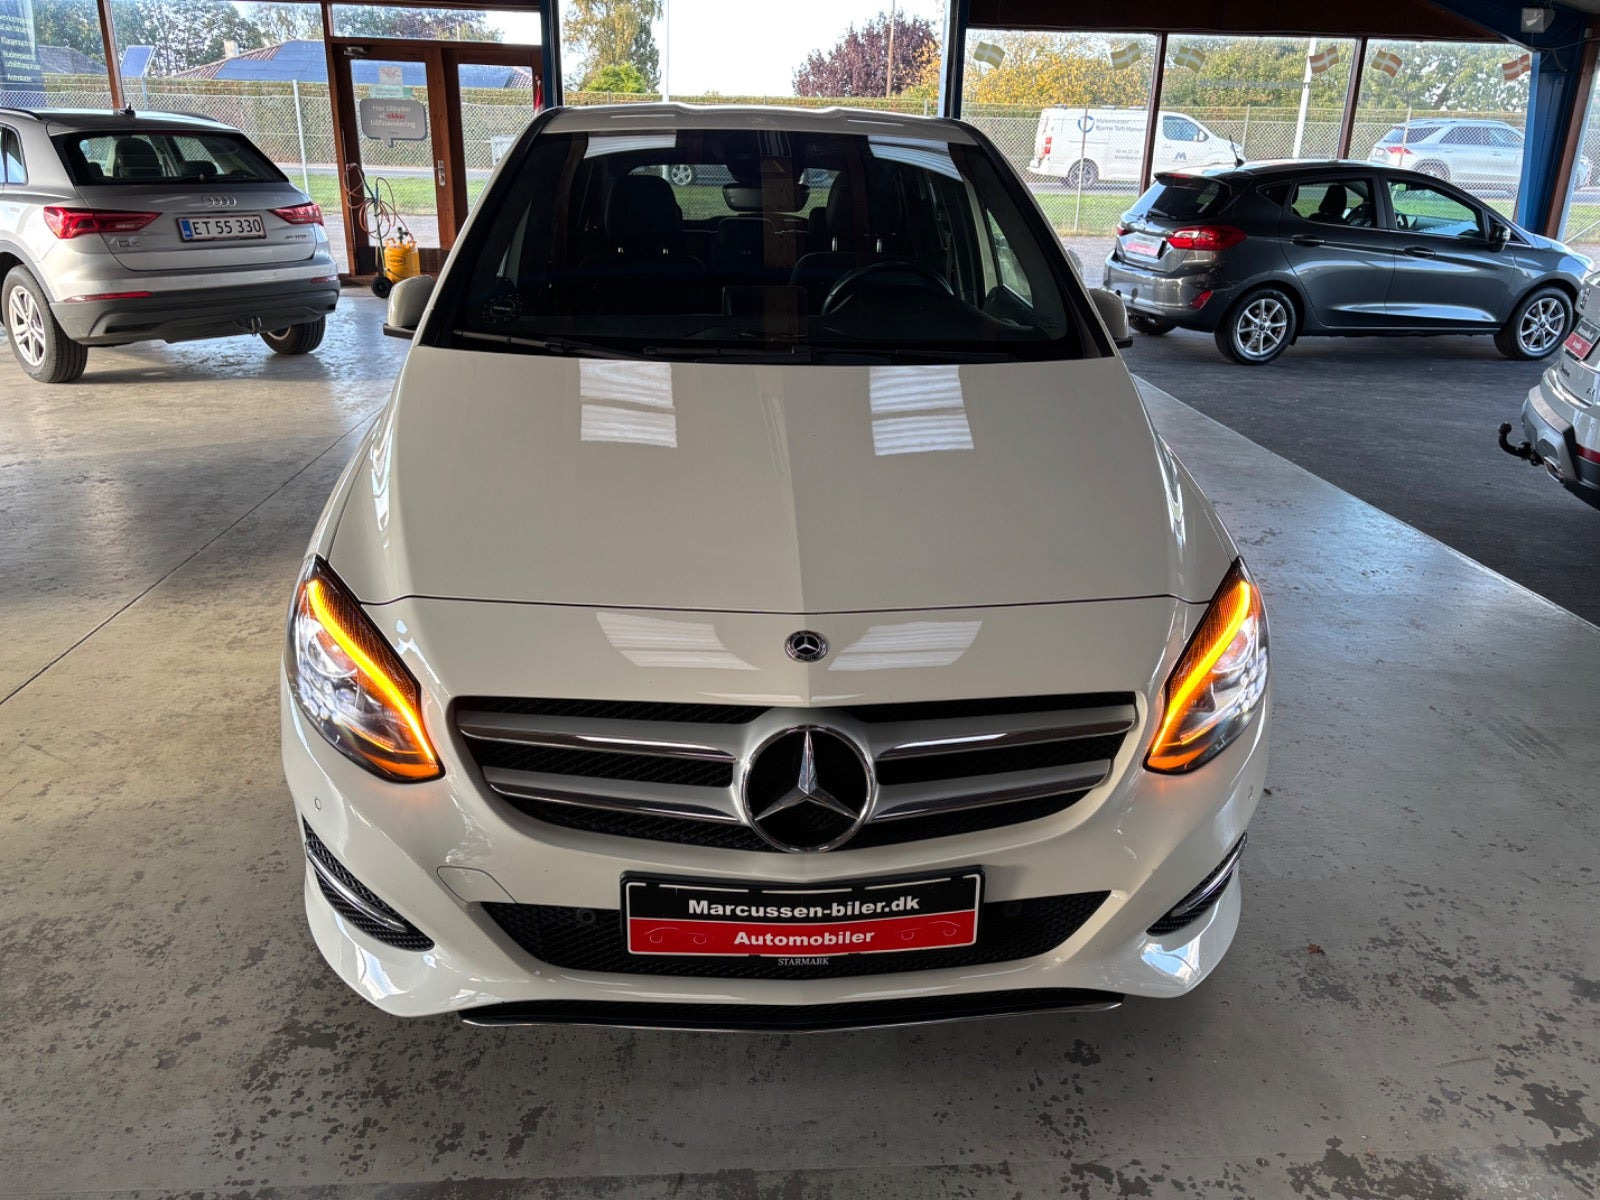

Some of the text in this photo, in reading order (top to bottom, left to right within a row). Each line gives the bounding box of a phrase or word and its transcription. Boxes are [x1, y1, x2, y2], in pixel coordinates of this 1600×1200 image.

[192, 219, 261, 235] ET 55 330
[687, 895, 921, 919] Marcussen-biler.dk
[733, 930, 876, 947] Automobiler
[777, 957, 830, 967] STARMARK
